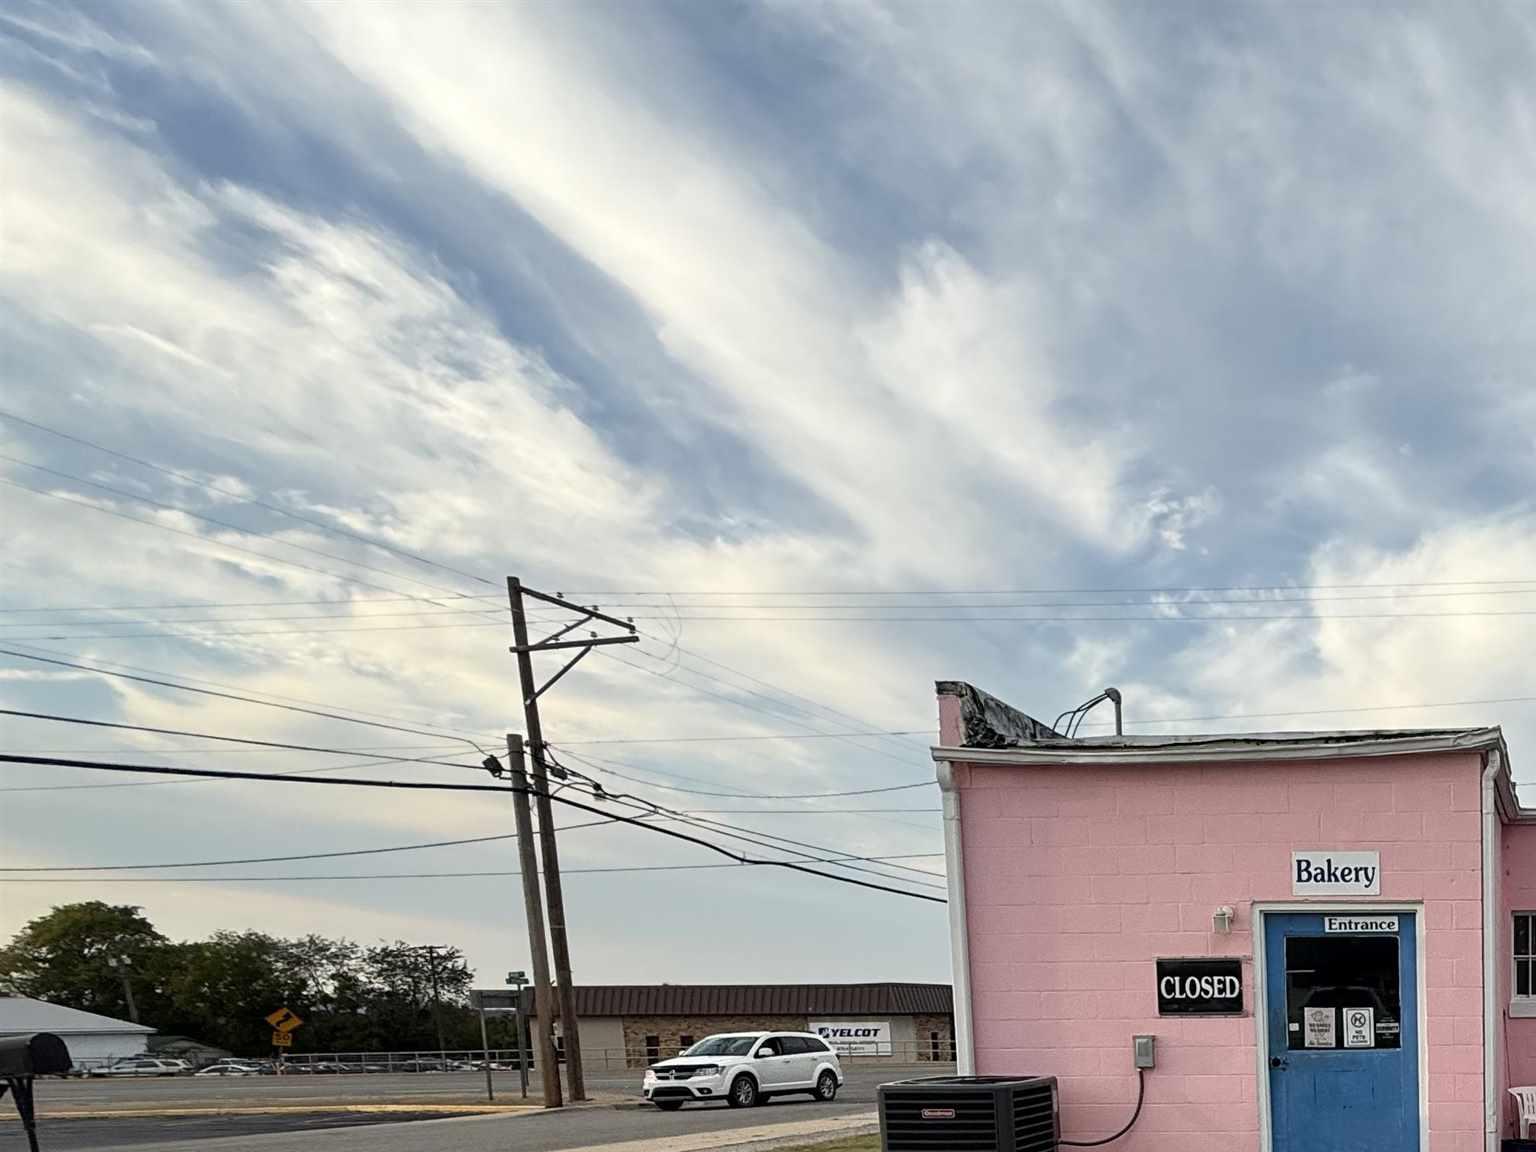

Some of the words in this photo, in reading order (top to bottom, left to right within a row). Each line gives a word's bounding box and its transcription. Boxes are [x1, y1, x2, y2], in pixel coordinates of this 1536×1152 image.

[1295, 859, 1376, 888] Bakery
[1327, 918, 1396, 931] Entrance
[1160, 976, 1240, 1000] CLOSED
[831, 1028, 881, 1037] YELCOT
